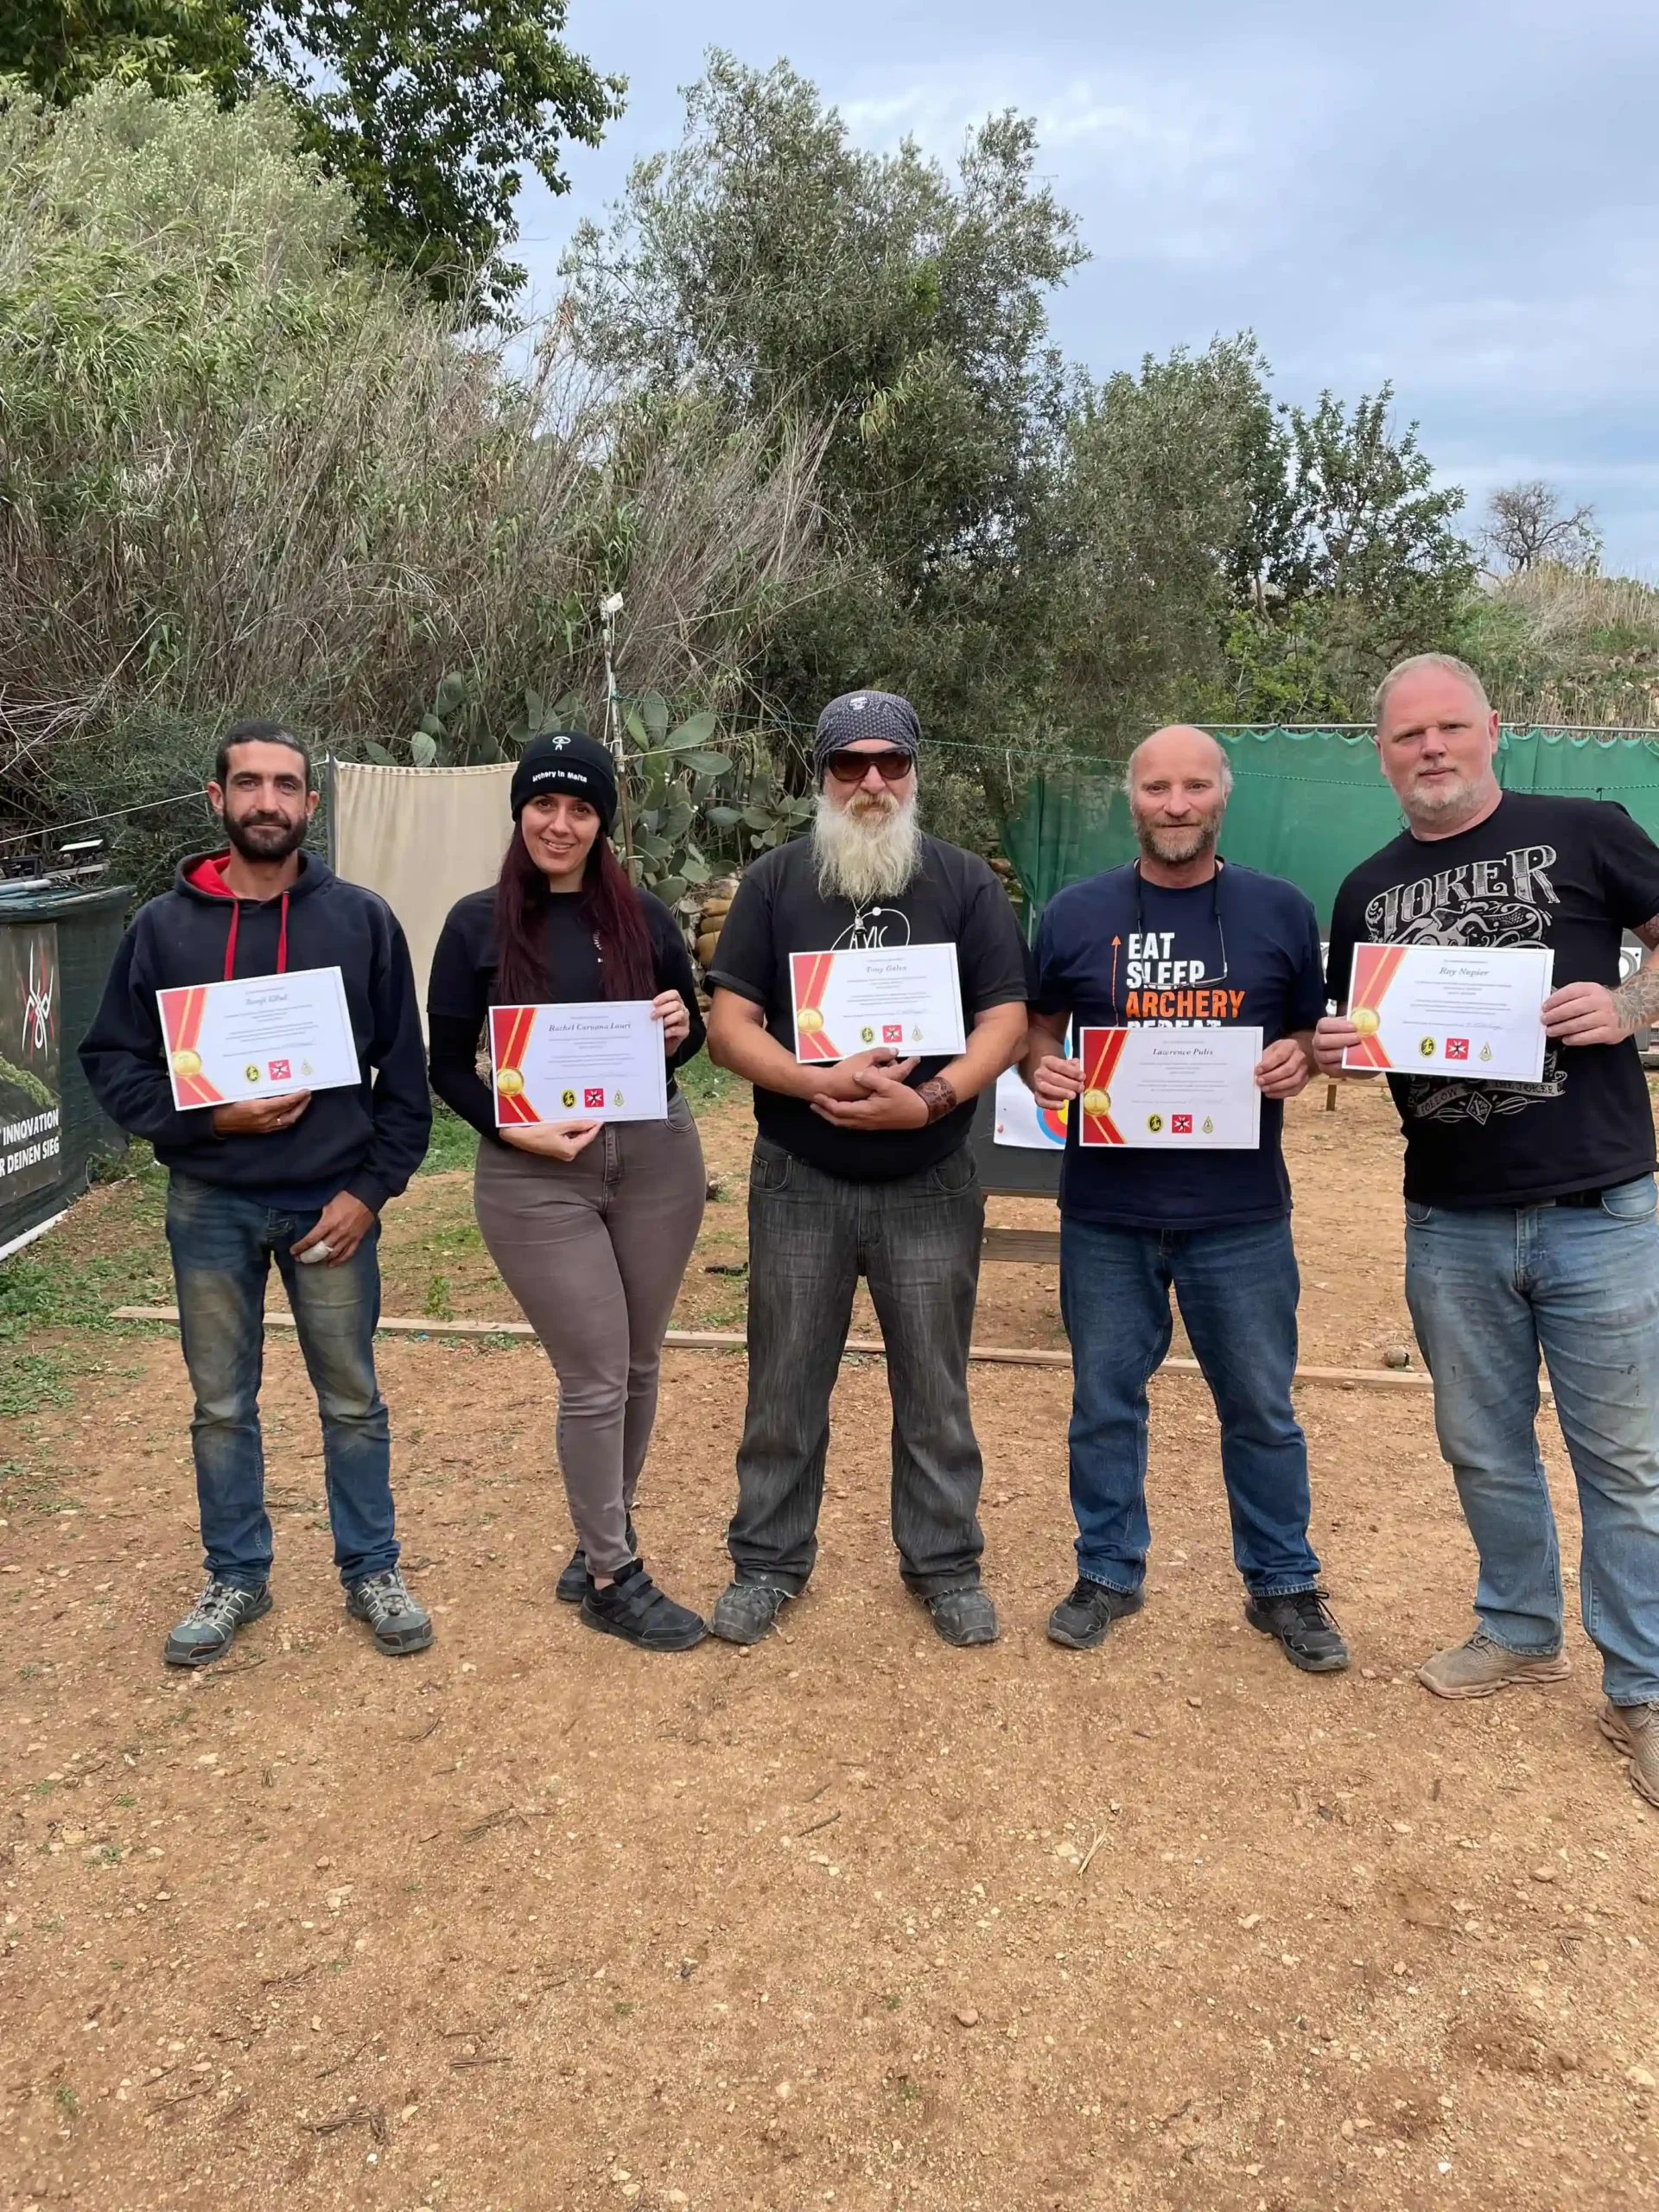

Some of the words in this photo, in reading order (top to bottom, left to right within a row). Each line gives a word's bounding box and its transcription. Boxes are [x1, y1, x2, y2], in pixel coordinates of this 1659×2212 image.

[567, 772, 588, 783] Malta
[1364, 844, 1560, 941] JOKER
[1128, 932, 1175, 959] EAT
[1126, 961, 1205, 988] SLEEP
[1439, 967, 1457, 976] Ray
[1459, 967, 1490, 977] Napier
[1126, 990, 1246, 1018] ARCHERY
[1516, 1082, 1554, 1095] JOKER
[3, 1108, 59, 1147] INNOVATION
[7, 1143, 41, 1174] DEINEN
[42, 1136, 60, 1160] SIEG
